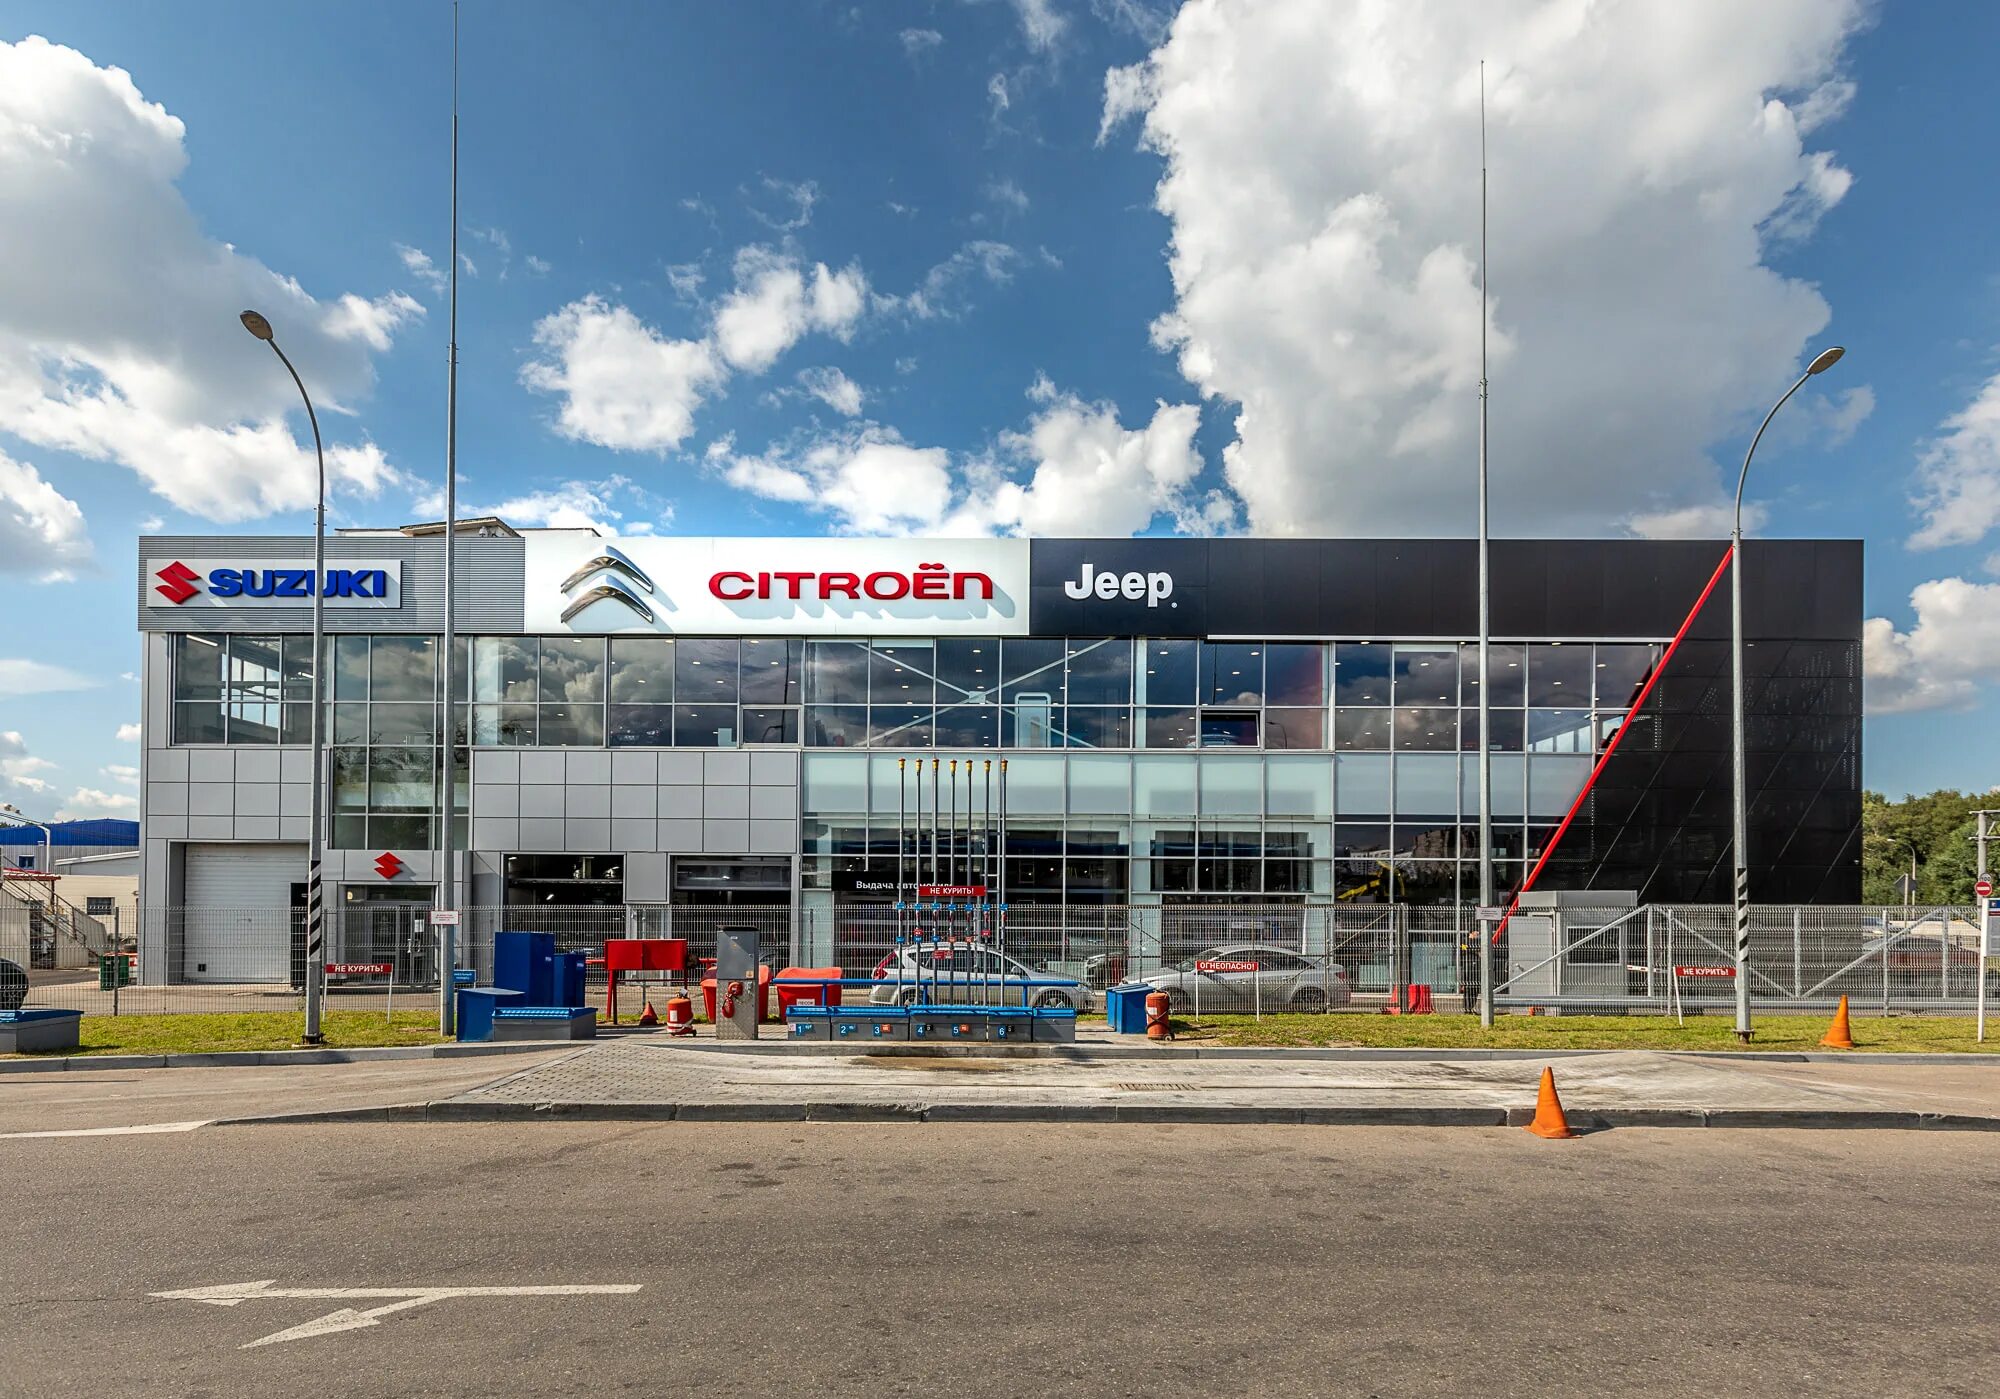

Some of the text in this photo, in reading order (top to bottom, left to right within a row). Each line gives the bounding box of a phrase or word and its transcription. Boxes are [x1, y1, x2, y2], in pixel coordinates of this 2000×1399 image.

[208, 568, 387, 598] SUZUKI
[1064, 563, 1173, 608] Jeep
[855, 880, 894, 891] Выдача
[929, 887, 974, 895] НЕ КУРИТЬ!
[334, 965, 384, 973] НЕ КУРИТЬ!
[1199, 962, 1255, 971] ОГНЕОПАСНО!
[1695, 968, 1729, 976] КУРИТЬ!
[797, 1025, 802, 1033] 1
[840, 1025, 846, 1034] 2
[874, 1025, 880, 1034] 3
[917, 1026, 923, 1034] 4
[953, 1026, 959, 1034] 5
[999, 1027, 1005, 1036] 6
